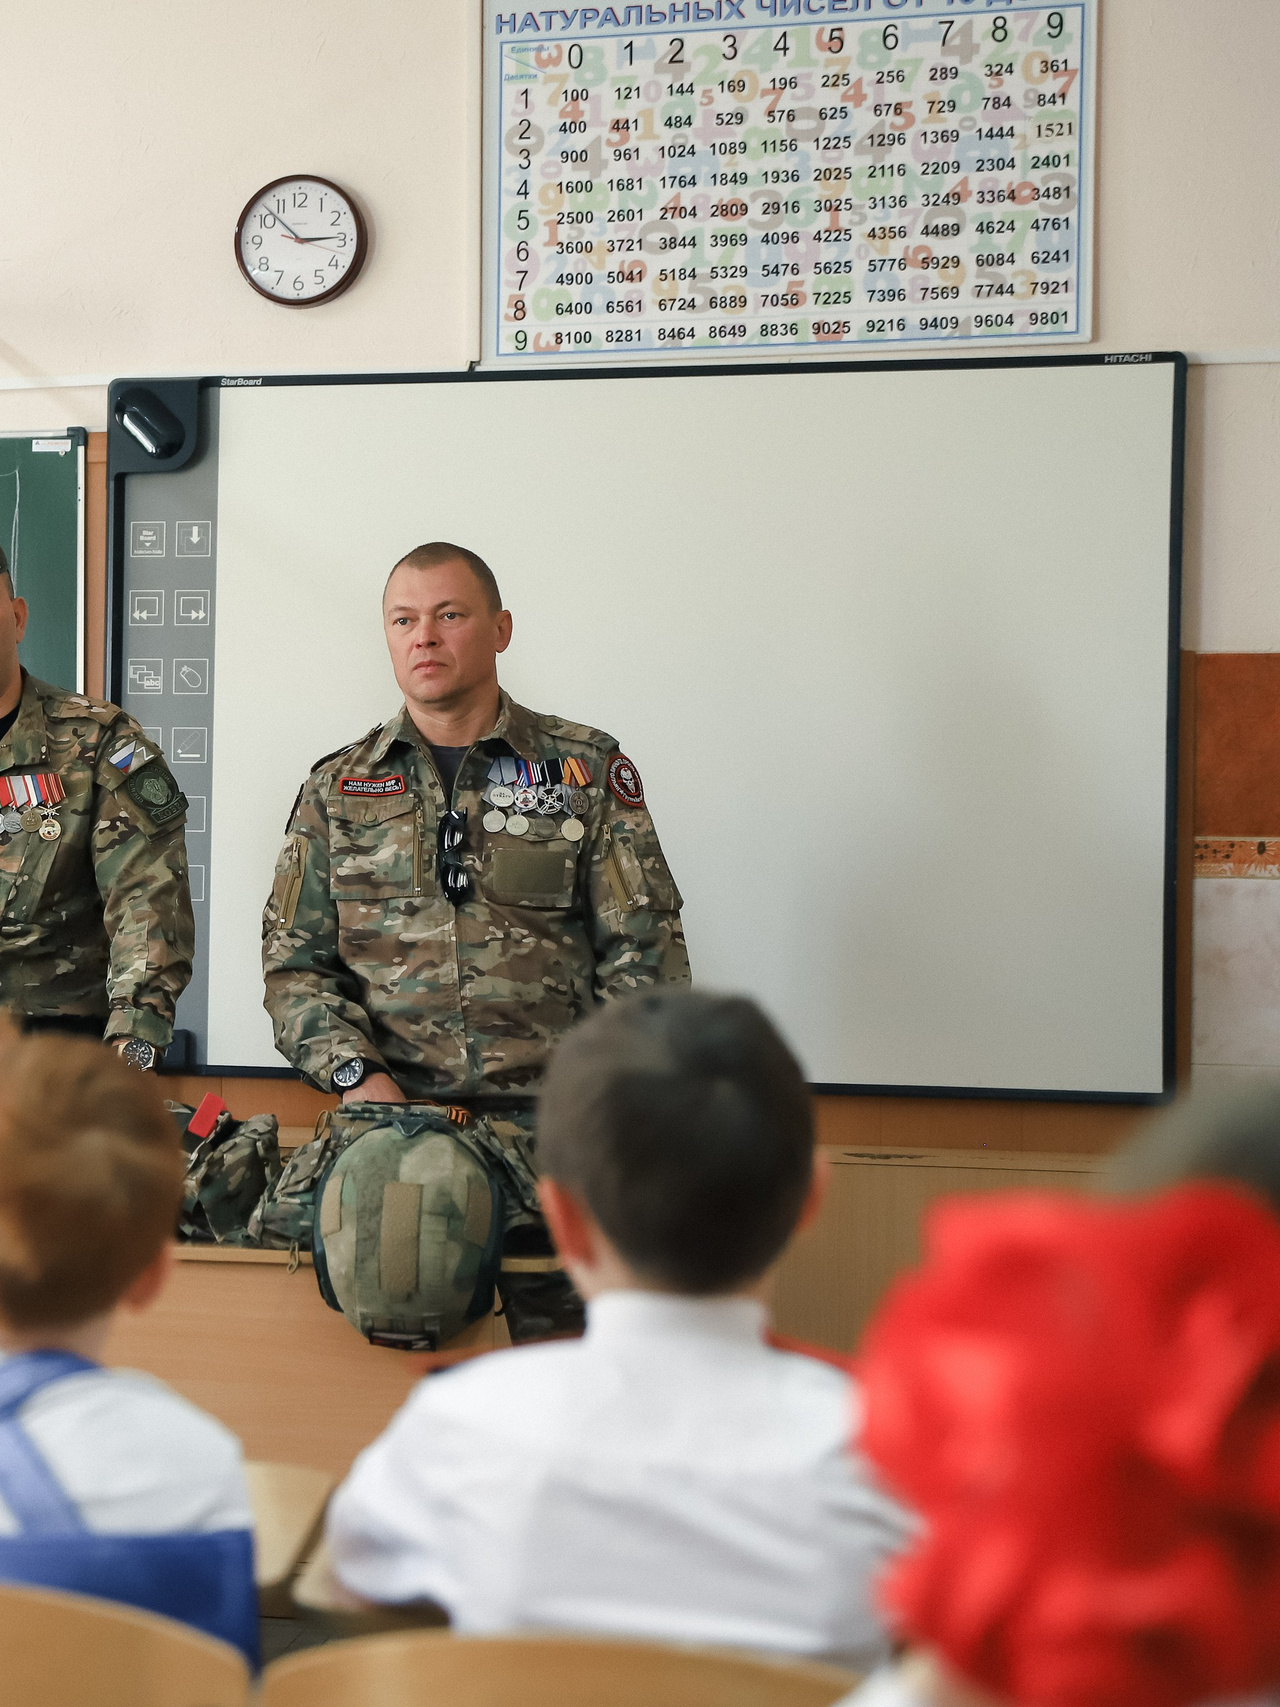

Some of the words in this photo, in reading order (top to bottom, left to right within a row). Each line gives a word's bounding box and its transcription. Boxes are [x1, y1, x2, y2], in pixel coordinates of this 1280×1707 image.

[495, 0, 747, 35] НАТУРАЛЬНЫХ
[568, 44, 583, 69] 0
[624, 41, 633, 65] 1
[668, 38, 684, 64] 2
[722, 35, 737, 60] 3
[774, 31, 789, 56] 4
[828, 28, 844, 53] 5
[883, 24, 898, 50] 6
[939, 20, 954, 46] 7
[992, 16, 1007, 42] 8
[1047, 12, 1063, 38] 9
[511, 45, 549, 54] Единицы
[504, 73, 538, 81] Десятки
[521, 89, 528, 109] 1
[562, 89, 588, 101] 100
[615, 86, 639, 99] 121
[668, 83, 694, 96] 144
[719, 80, 745, 93] 169
[770, 77, 797, 90] 196
[822, 74, 850, 87] 225
[876, 70, 905, 84] 256
[930, 67, 958, 80] 289
[985, 63, 1013, 77] 324
[1041, 59, 1067, 73] 361
[519, 119, 531, 139] 2
[559, 121, 586, 134] 400
[612, 119, 637, 132] 441
[664, 115, 692, 128] 484
[716, 112, 743, 126] 529
[768, 110, 795, 123] 576
[819, 107, 847, 120] 625
[874, 103, 902, 116] 676
[927, 100, 956, 113] 729
[982, 96, 1011, 110] 784
[1037, 93, 1065, 107] 841
[519, 149, 530, 169] 3
[561, 150, 587, 163] 900
[614, 148, 639, 161] 961
[659, 145, 695, 158] 1024
[710, 142, 746, 155] 1089
[761, 139, 797, 153] 1156
[814, 136, 851, 150] 1225
[868, 133, 906, 147] 1296
[921, 130, 959, 143] 1369
[976, 126, 1014, 140] 1444
[1038, 122, 1072, 137] 1521
[517, 180, 529, 199] 4
[557, 180, 593, 193] 1600
[608, 178, 642, 191] 1681
[660, 175, 697, 188] 1764
[711, 172, 747, 186] 1849
[762, 170, 799, 183] 1936
[814, 167, 852, 181] 2025
[868, 164, 906, 178] 2116
[921, 161, 960, 175] 2209
[976, 157, 1015, 172] 2304
[1031, 154, 1069, 169] 2401
[276, 199, 286, 214] 11
[292, 192, 308, 208] 12
[319, 197, 323, 212] 1
[518, 210, 529, 230] 5
[557, 211, 593, 224] 2500
[607, 209, 642, 222] 2601
[660, 206, 697, 220] 2704
[710, 203, 748, 217] 2809
[762, 201, 800, 214] 2916
[814, 198, 852, 212] 3025
[869, 195, 907, 209] 3136
[922, 192, 960, 207] 3249
[977, 189, 1016, 203] 3364
[1032, 186, 1070, 200] 3481
[259, 213, 276, 229] 10
[330, 211, 341, 226] 2
[251, 235, 263, 250] 9
[336, 232, 347, 248] 3
[517, 241, 529, 261] 6
[557, 241, 592, 254] 3600
[607, 239, 642, 252] 3721
[659, 236, 696, 250] 3844
[711, 234, 747, 247] 3969
[761, 231, 799, 245] 4096
[813, 229, 851, 242] 4225
[868, 226, 906, 240] 4356
[921, 223, 960, 237] 4489
[976, 220, 1015, 234] 4624
[1031, 217, 1069, 231] 4761
[258, 256, 269, 272] 8
[328, 255, 339, 270] 4
[516, 271, 528, 291] 7
[556, 272, 593, 285] 4900
[607, 270, 642, 283] 5041
[660, 268, 697, 281] 5184
[710, 265, 747, 279] 5329
[762, 263, 799, 277] 5476
[814, 261, 852, 275] 5625
[868, 258, 906, 272] 5776
[921, 256, 960, 270] 5929
[976, 253, 1015, 267] 6084
[1032, 250, 1069, 264] 6241
[274, 270, 284, 286] 7
[293, 275, 304, 291] 6
[314, 269, 325, 285] 5
[514, 300, 526, 320] 8
[556, 302, 592, 315] 6400
[606, 300, 641, 313] 6561
[659, 298, 696, 311] 6724
[710, 295, 747, 309] 6889
[761, 293, 799, 307] 7056
[813, 291, 851, 305] 7225
[867, 289, 906, 302] 7396
[920, 286, 959, 300] 7569
[975, 284, 1014, 297] 7744
[1031, 281, 1068, 294] 7921
[515, 330, 527, 350] 9
[555, 331, 591, 344] 8100
[606, 329, 640, 342] 8281
[658, 327, 695, 340] 8464
[709, 325, 746, 338] 8649
[760, 323, 798, 336] 8836
[812, 321, 850, 334] 9025
[867, 319, 905, 332] 9216
[920, 317, 958, 330] 9409
[975, 314, 1014, 328] 9604
[1030, 311, 1067, 325] 9801
[1104, 353, 1152, 364] HITACHI
[221, 377, 262, 386] StarBoard
[385, 779, 396, 787] МИР
